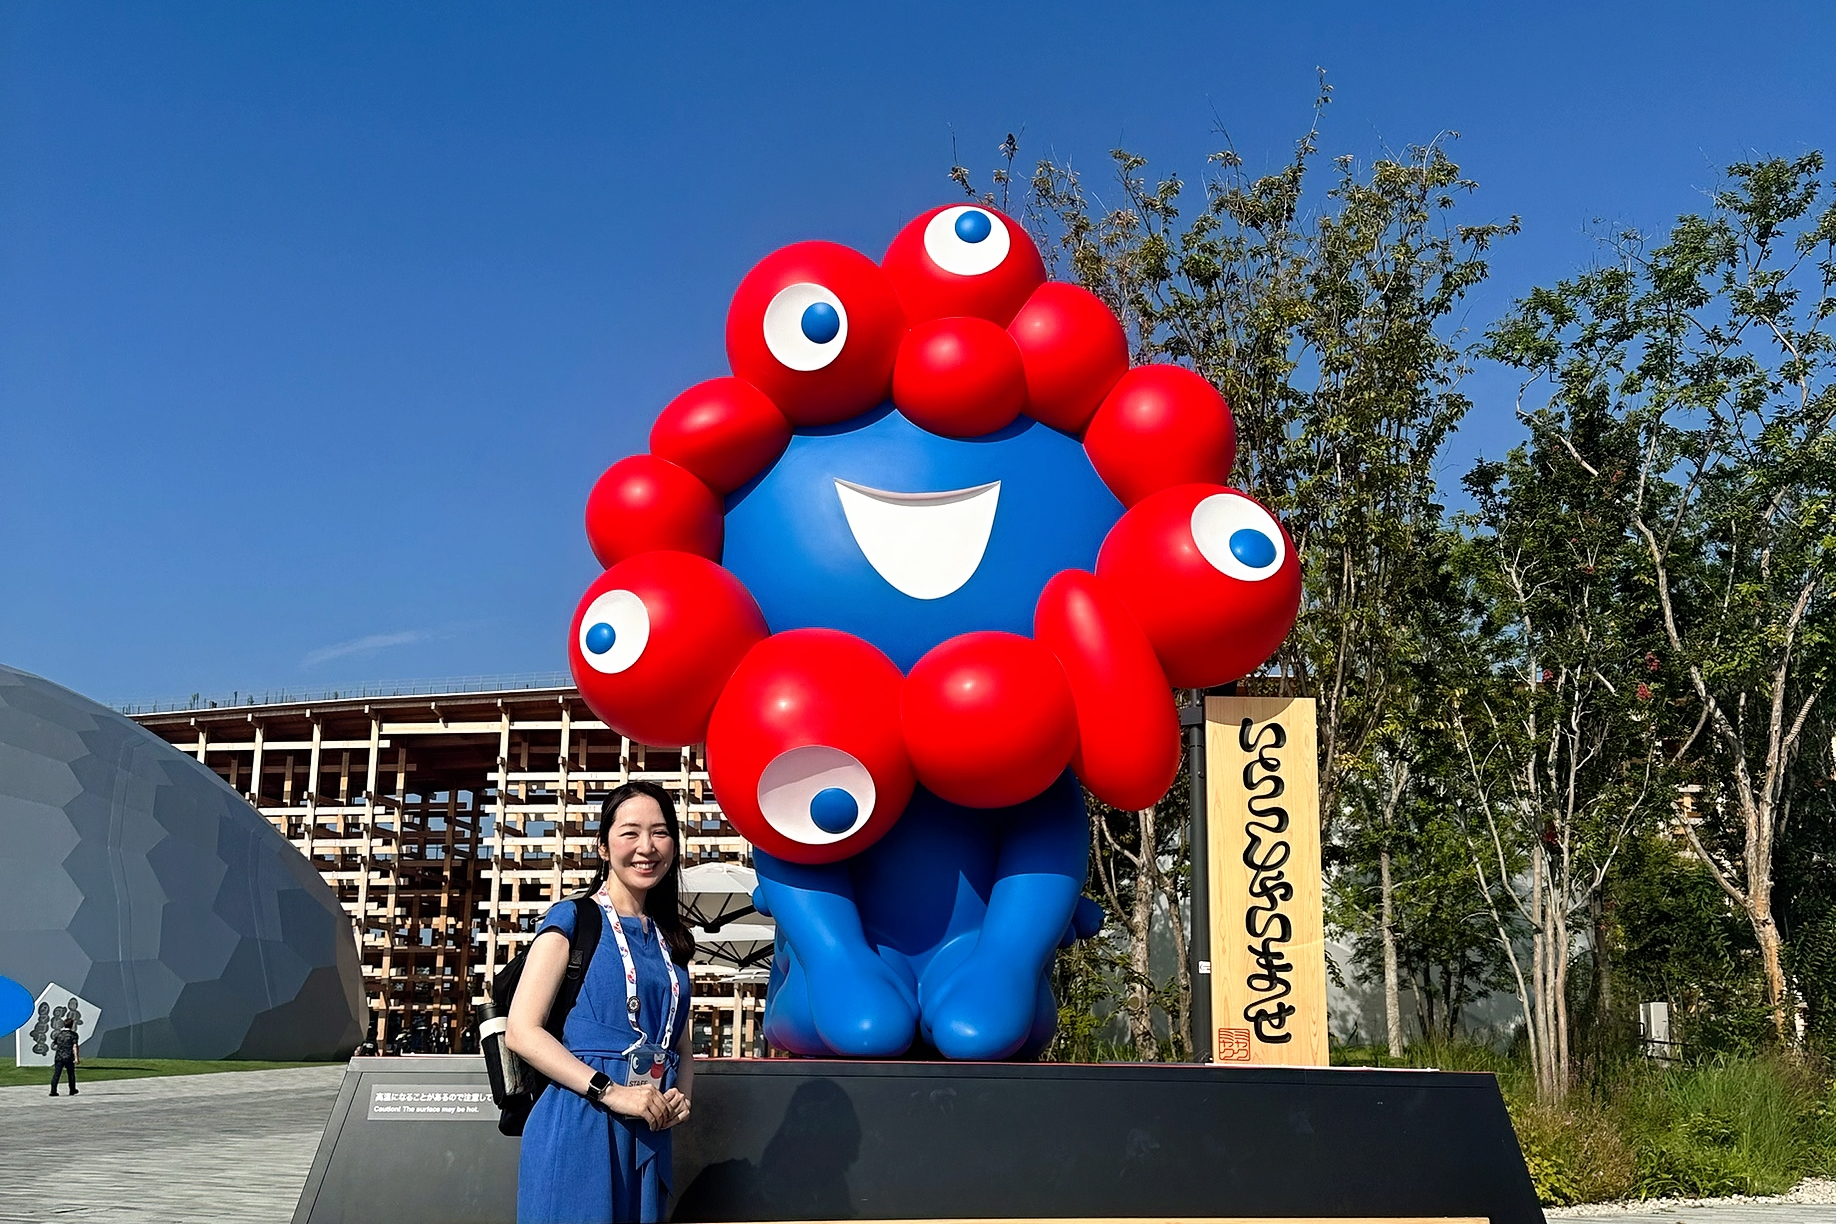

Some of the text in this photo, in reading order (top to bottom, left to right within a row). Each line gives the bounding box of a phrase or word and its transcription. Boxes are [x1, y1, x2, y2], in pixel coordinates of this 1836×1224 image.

[375, 1092, 493, 1102] 高温になることがあるので注意して
[373, 1105, 479, 1115] Caution! The surface may be hot.
